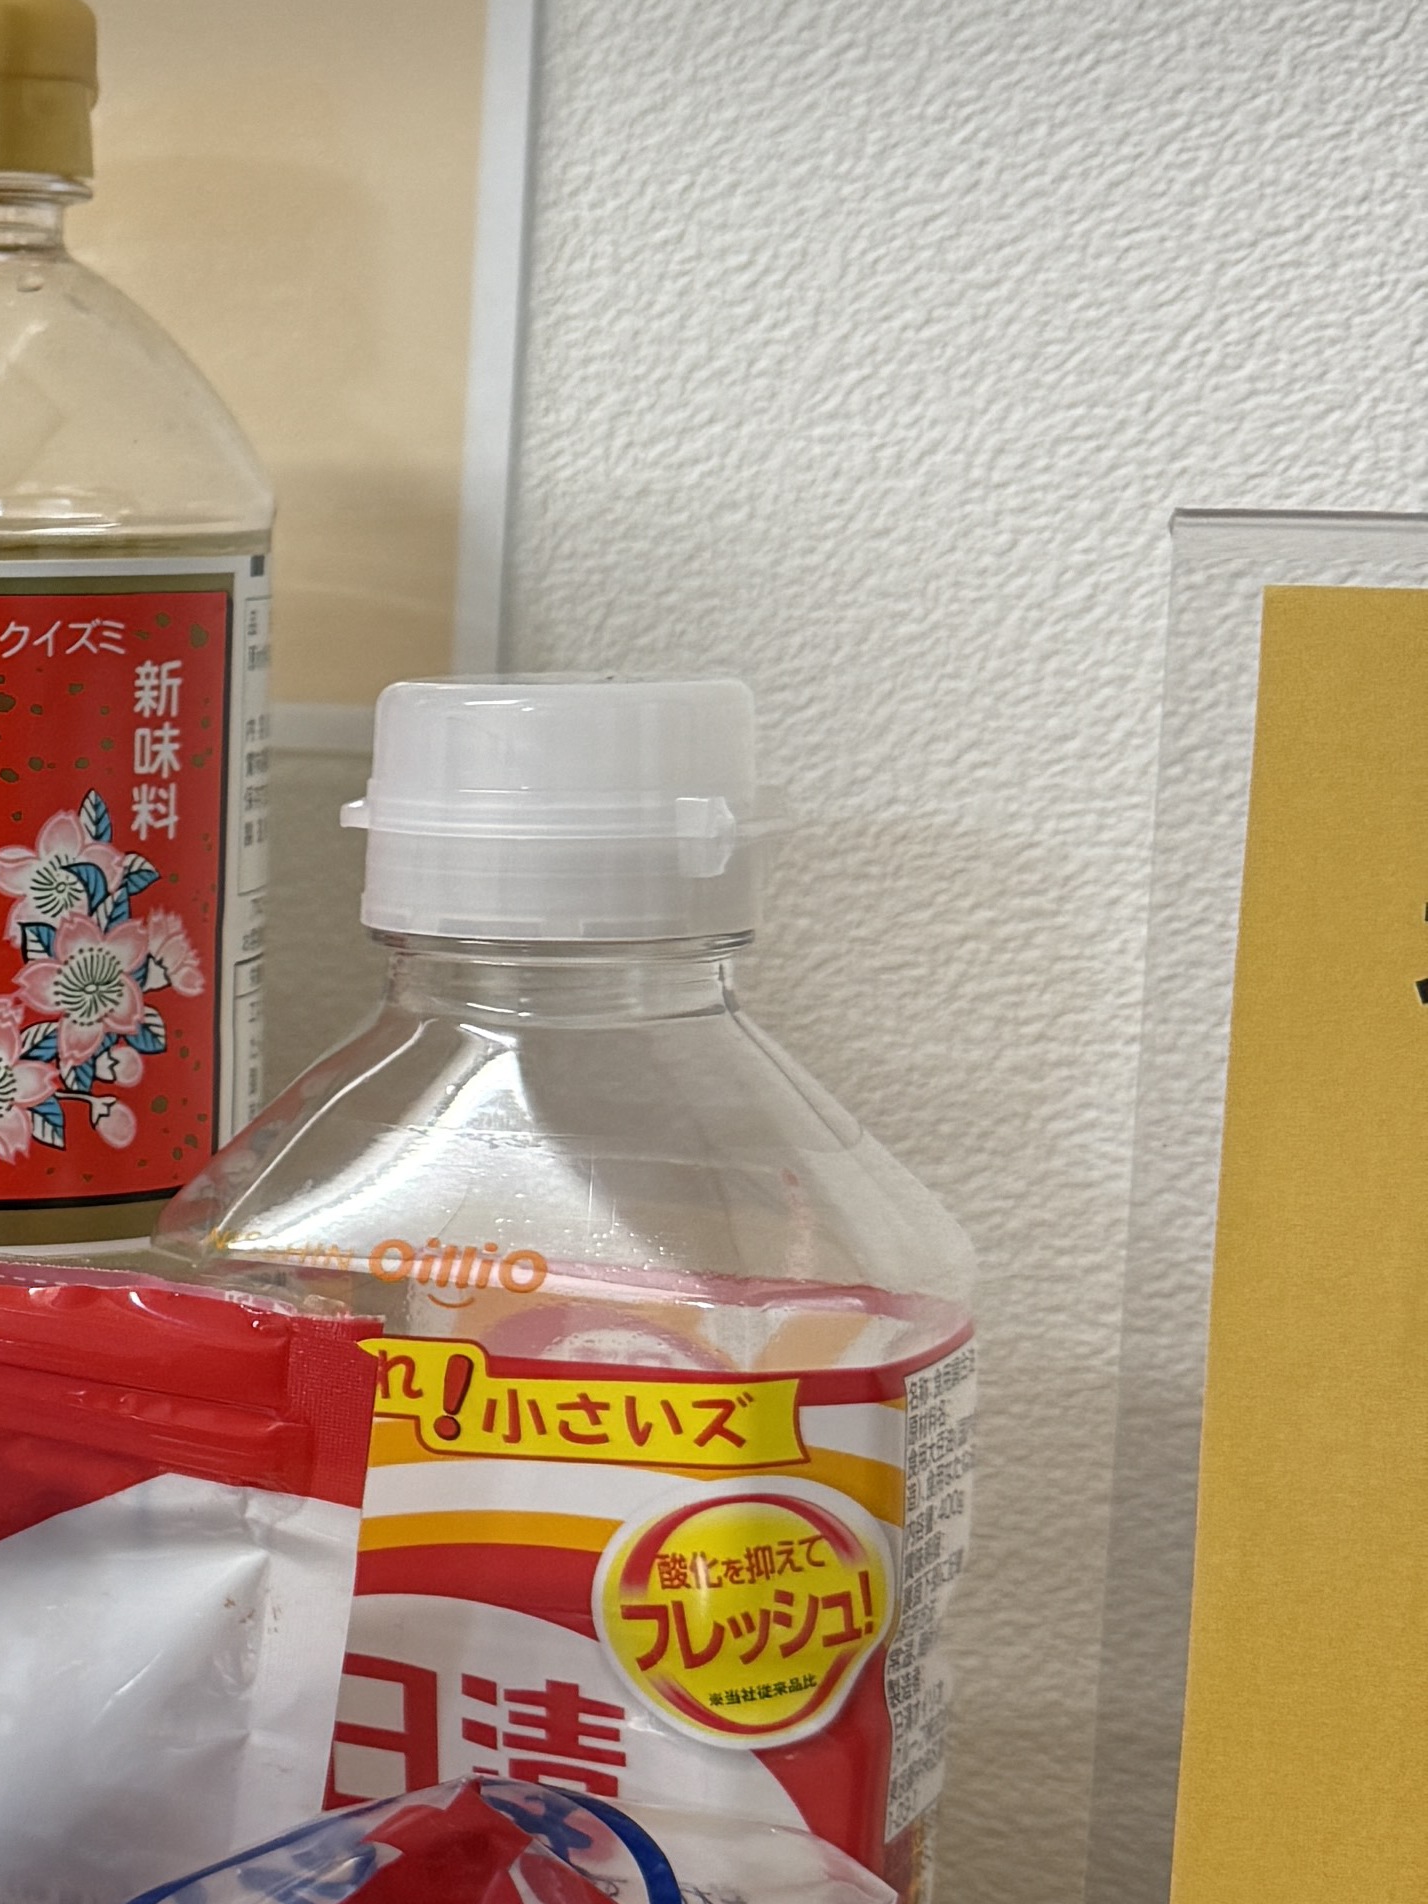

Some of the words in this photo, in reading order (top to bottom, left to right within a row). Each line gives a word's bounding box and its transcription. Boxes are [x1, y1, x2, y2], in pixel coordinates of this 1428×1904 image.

[130, 660, 183, 841] 新味料
[657, 1535, 828, 1589] 酸化を抑えて
[622, 1573, 877, 1672] フレッシュ!
